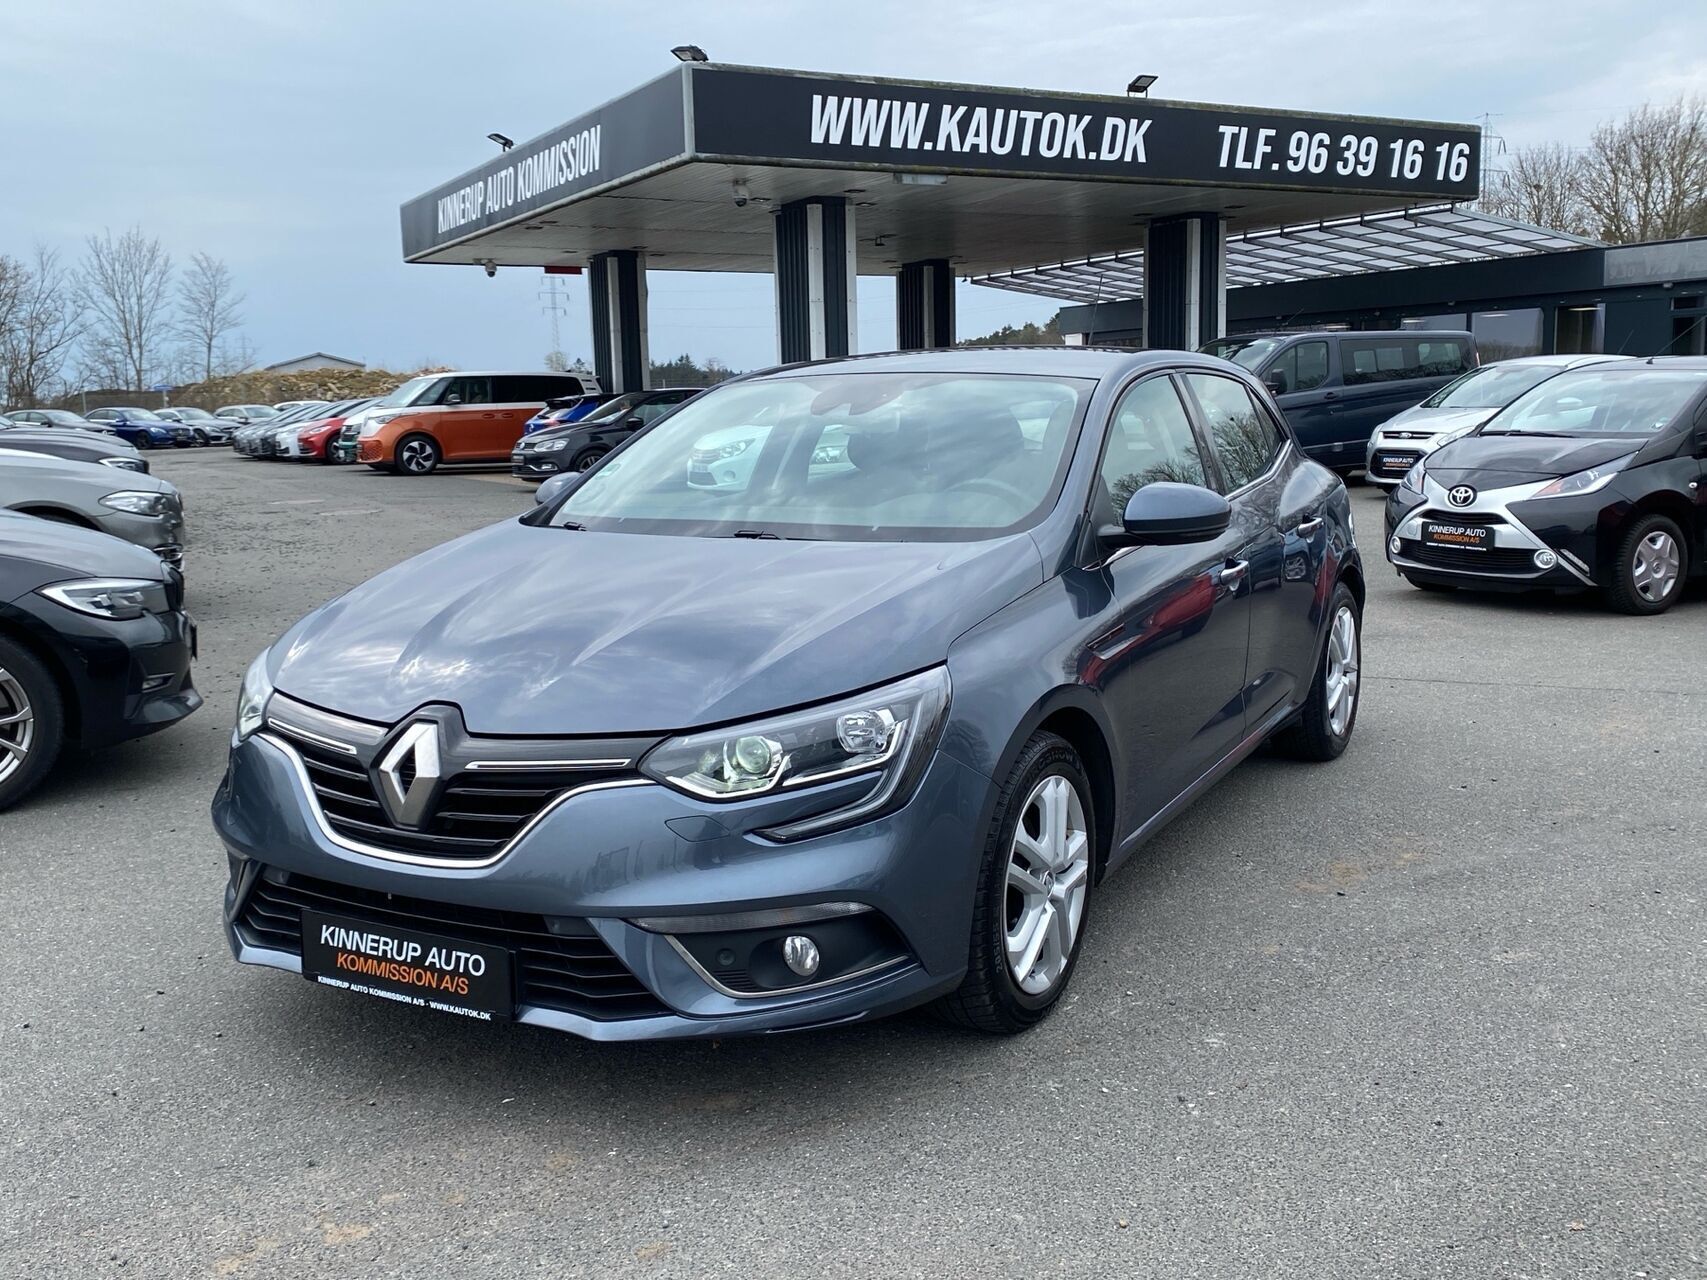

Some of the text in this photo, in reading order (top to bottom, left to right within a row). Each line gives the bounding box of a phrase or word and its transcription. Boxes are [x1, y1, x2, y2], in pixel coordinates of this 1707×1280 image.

[811, 94, 1152, 163] WWW.KAUTOK.DK
[1218, 124, 1470, 182] TLF. 96 39 16 16
[438, 125, 601, 234] KINNERUP AUTO KOMMISSION
[1428, 525, 1487, 538] KINNERUP AUTO
[320, 924, 486, 977] KINNERUP AUTO
[336, 952, 469, 995] KOMMISSION A/S
[317, 975, 350, 989] KINNERUP
[350, 983, 369, 994] AUTO
[368, 987, 412, 1004] KOMMISSION
[412, 997, 425, 1007] A/S
[429, 1001, 492, 1021] WWW.KAUTOK.DK
